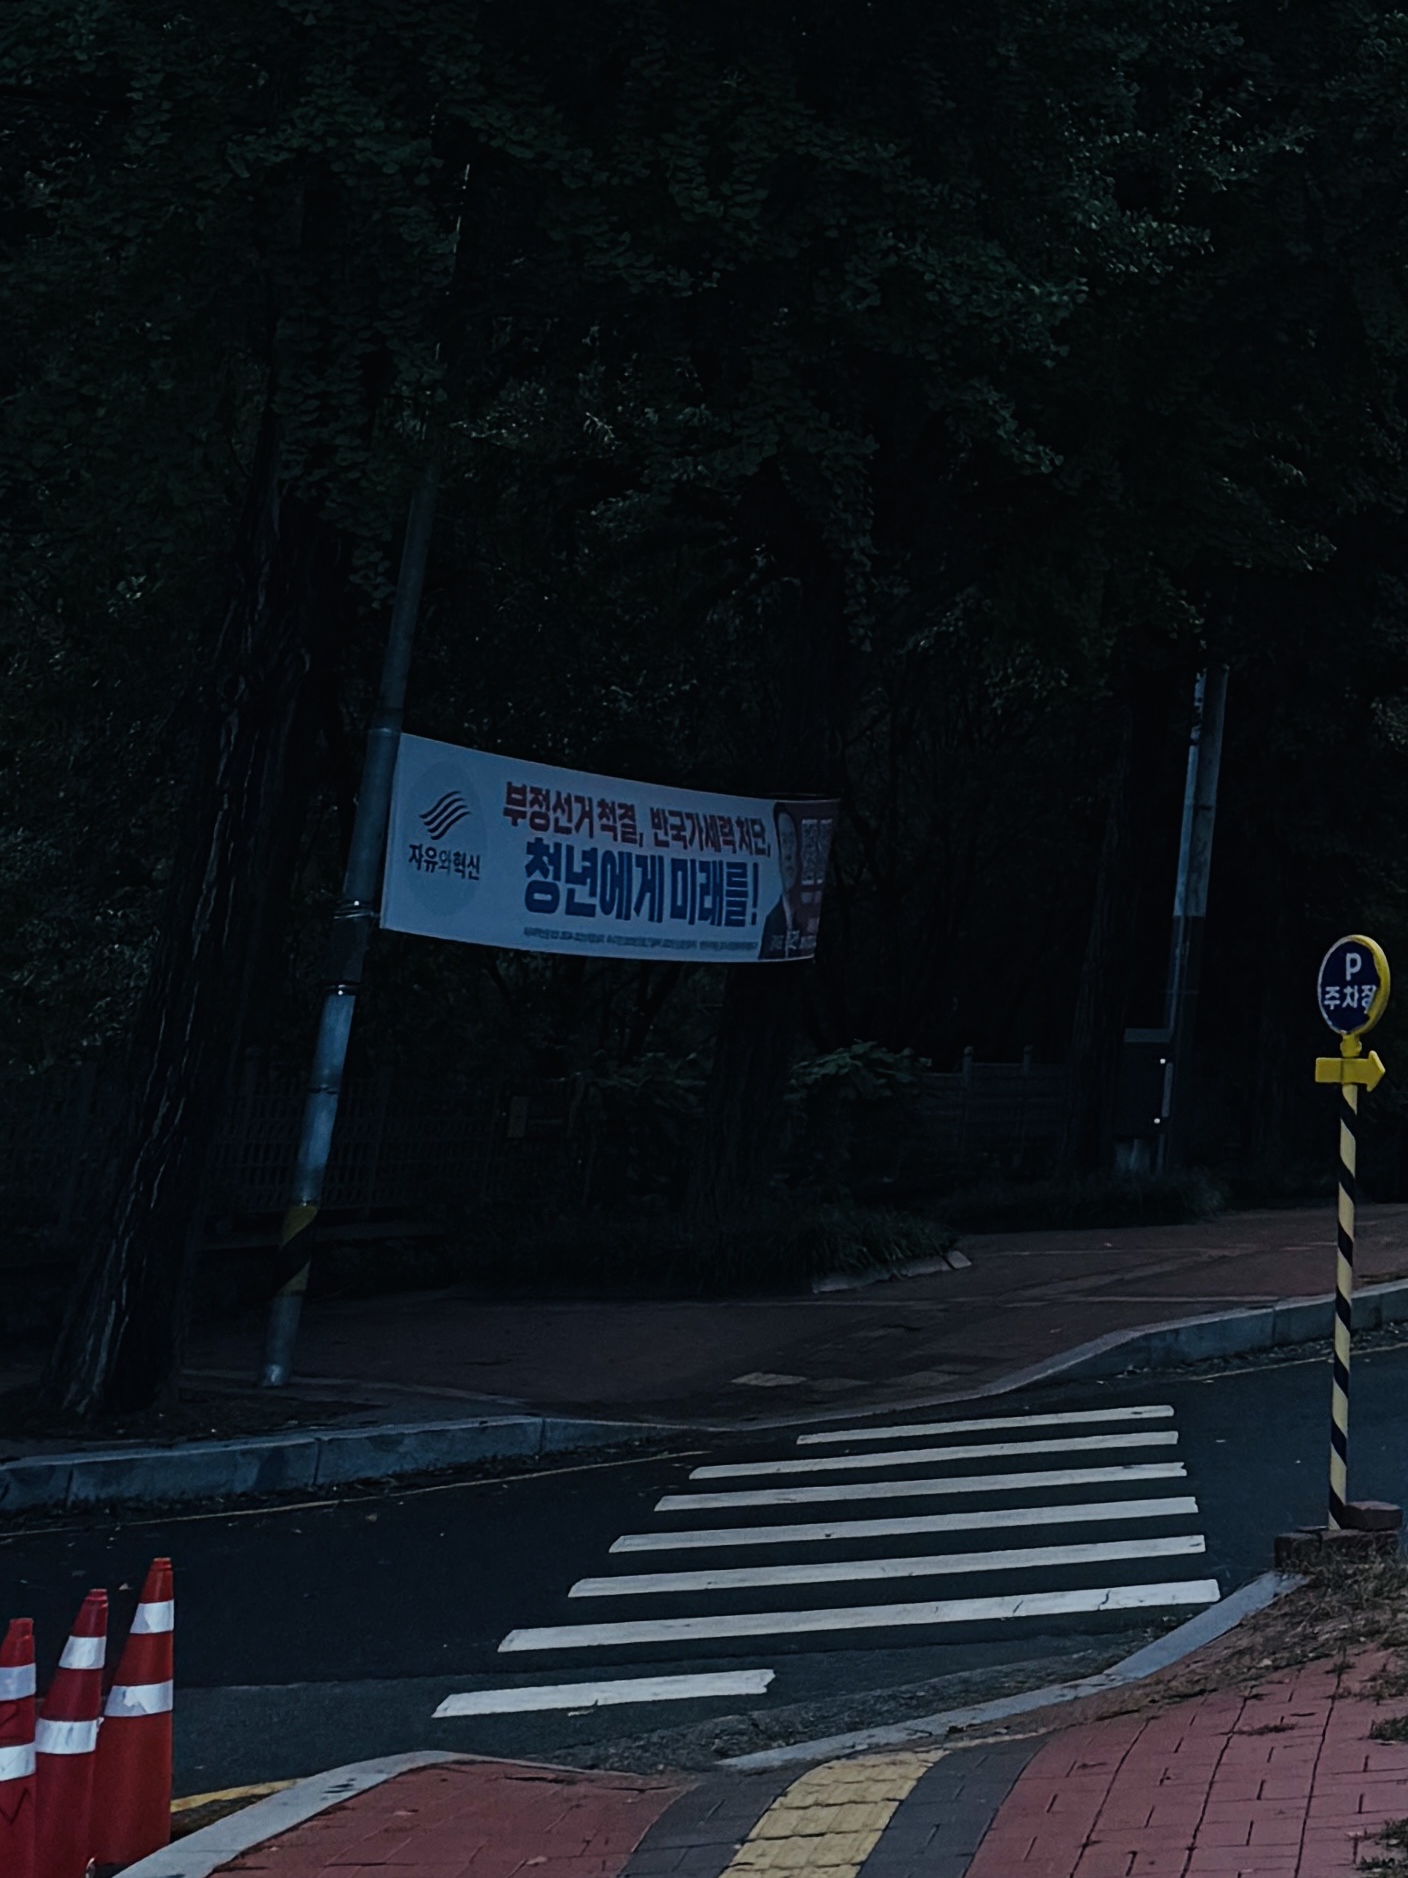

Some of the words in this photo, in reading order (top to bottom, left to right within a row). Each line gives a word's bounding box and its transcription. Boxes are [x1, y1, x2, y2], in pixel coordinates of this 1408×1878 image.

[503, 781, 594, 839] 부정선거
[597, 798, 643, 848] 척결,
[650, 807, 736, 854] 반국가세력
[408, 843, 481, 881] 자유와혁신
[524, 836, 664, 923] 청년에게
[670, 857, 759, 928] 미래를!
[1344, 952, 1363, 982] P
